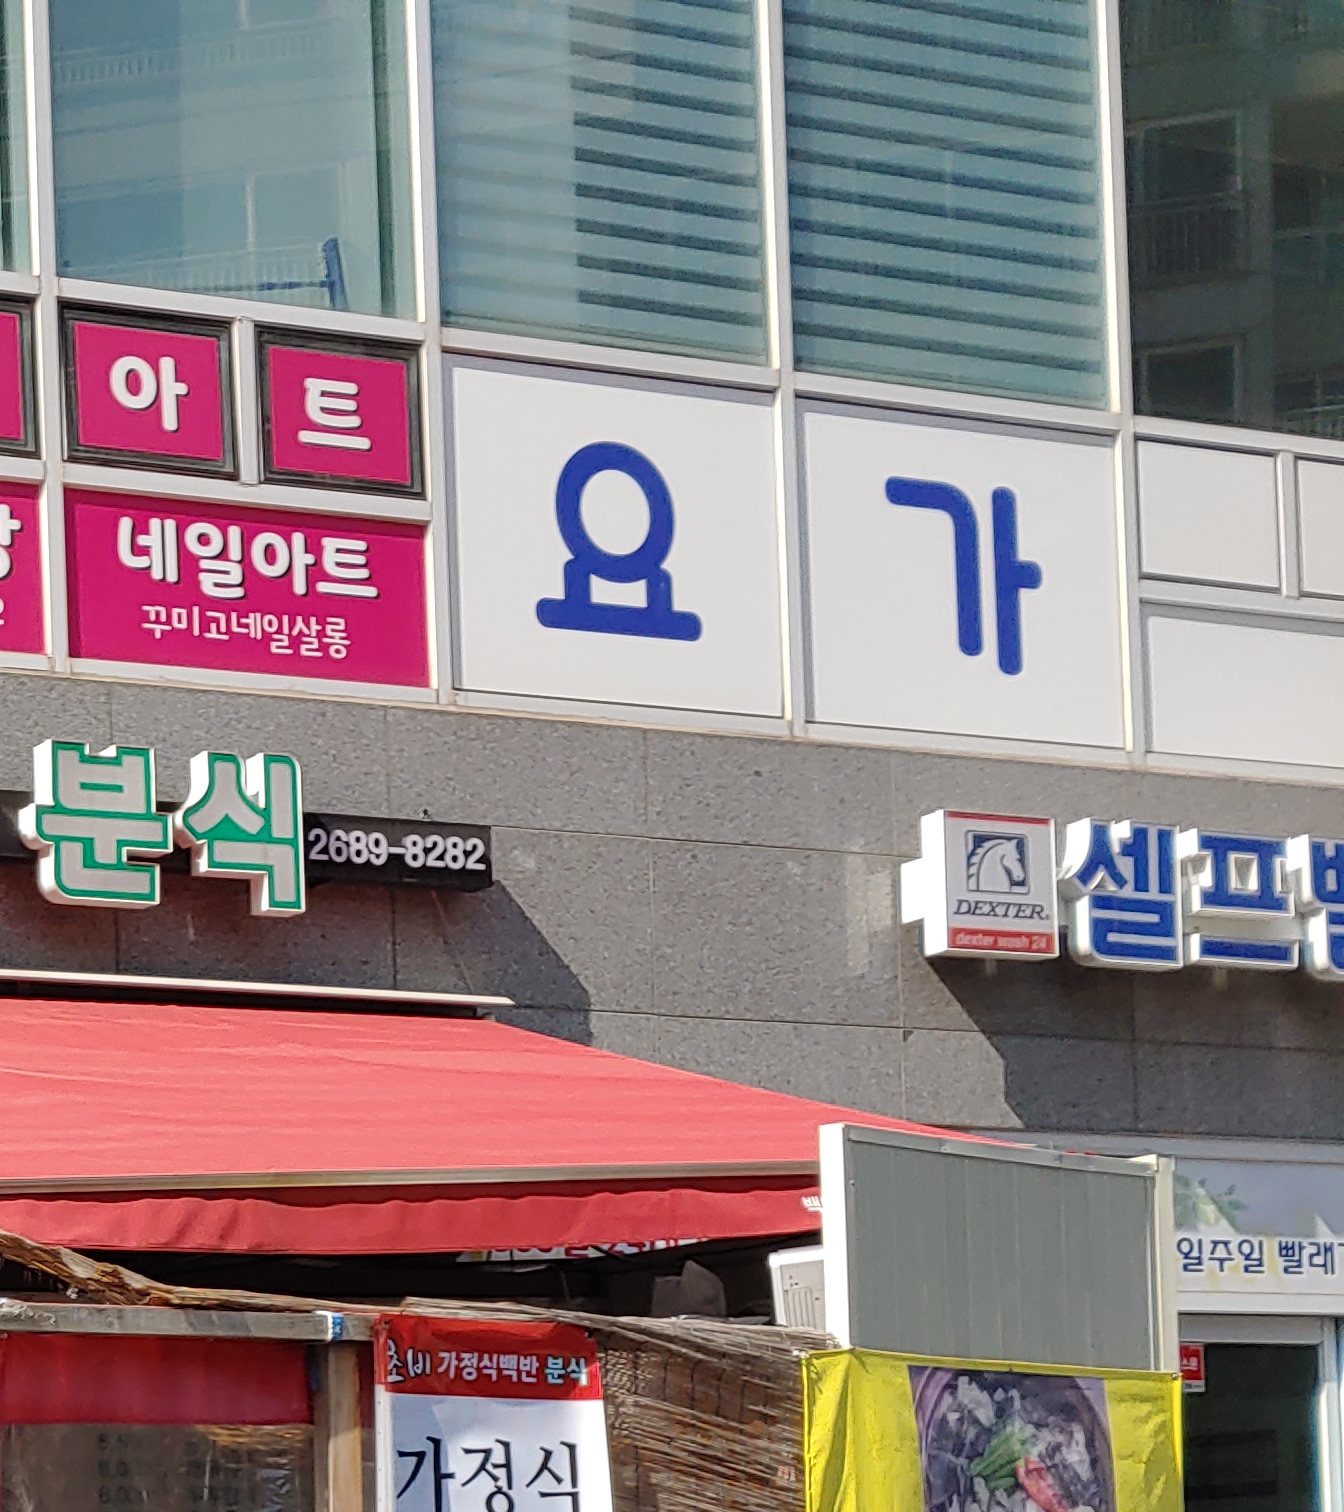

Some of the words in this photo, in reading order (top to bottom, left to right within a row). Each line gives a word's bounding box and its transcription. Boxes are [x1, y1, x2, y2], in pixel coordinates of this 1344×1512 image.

[116, 515, 379, 600] 네일아트
[141, 604, 352, 660] 꾸미고네일살롱
[18, 736, 306, 918] 분식
[308, 826, 488, 874] 2689-8282
[953, 898, 1045, 920] DEXTER
[1176, 1236, 1266, 1274] 일주일
[1277, 1239, 1344, 1275] 빨래
[437, 1350, 540, 1383] 가정식백반
[544, 1354, 589, 1387] 분식
